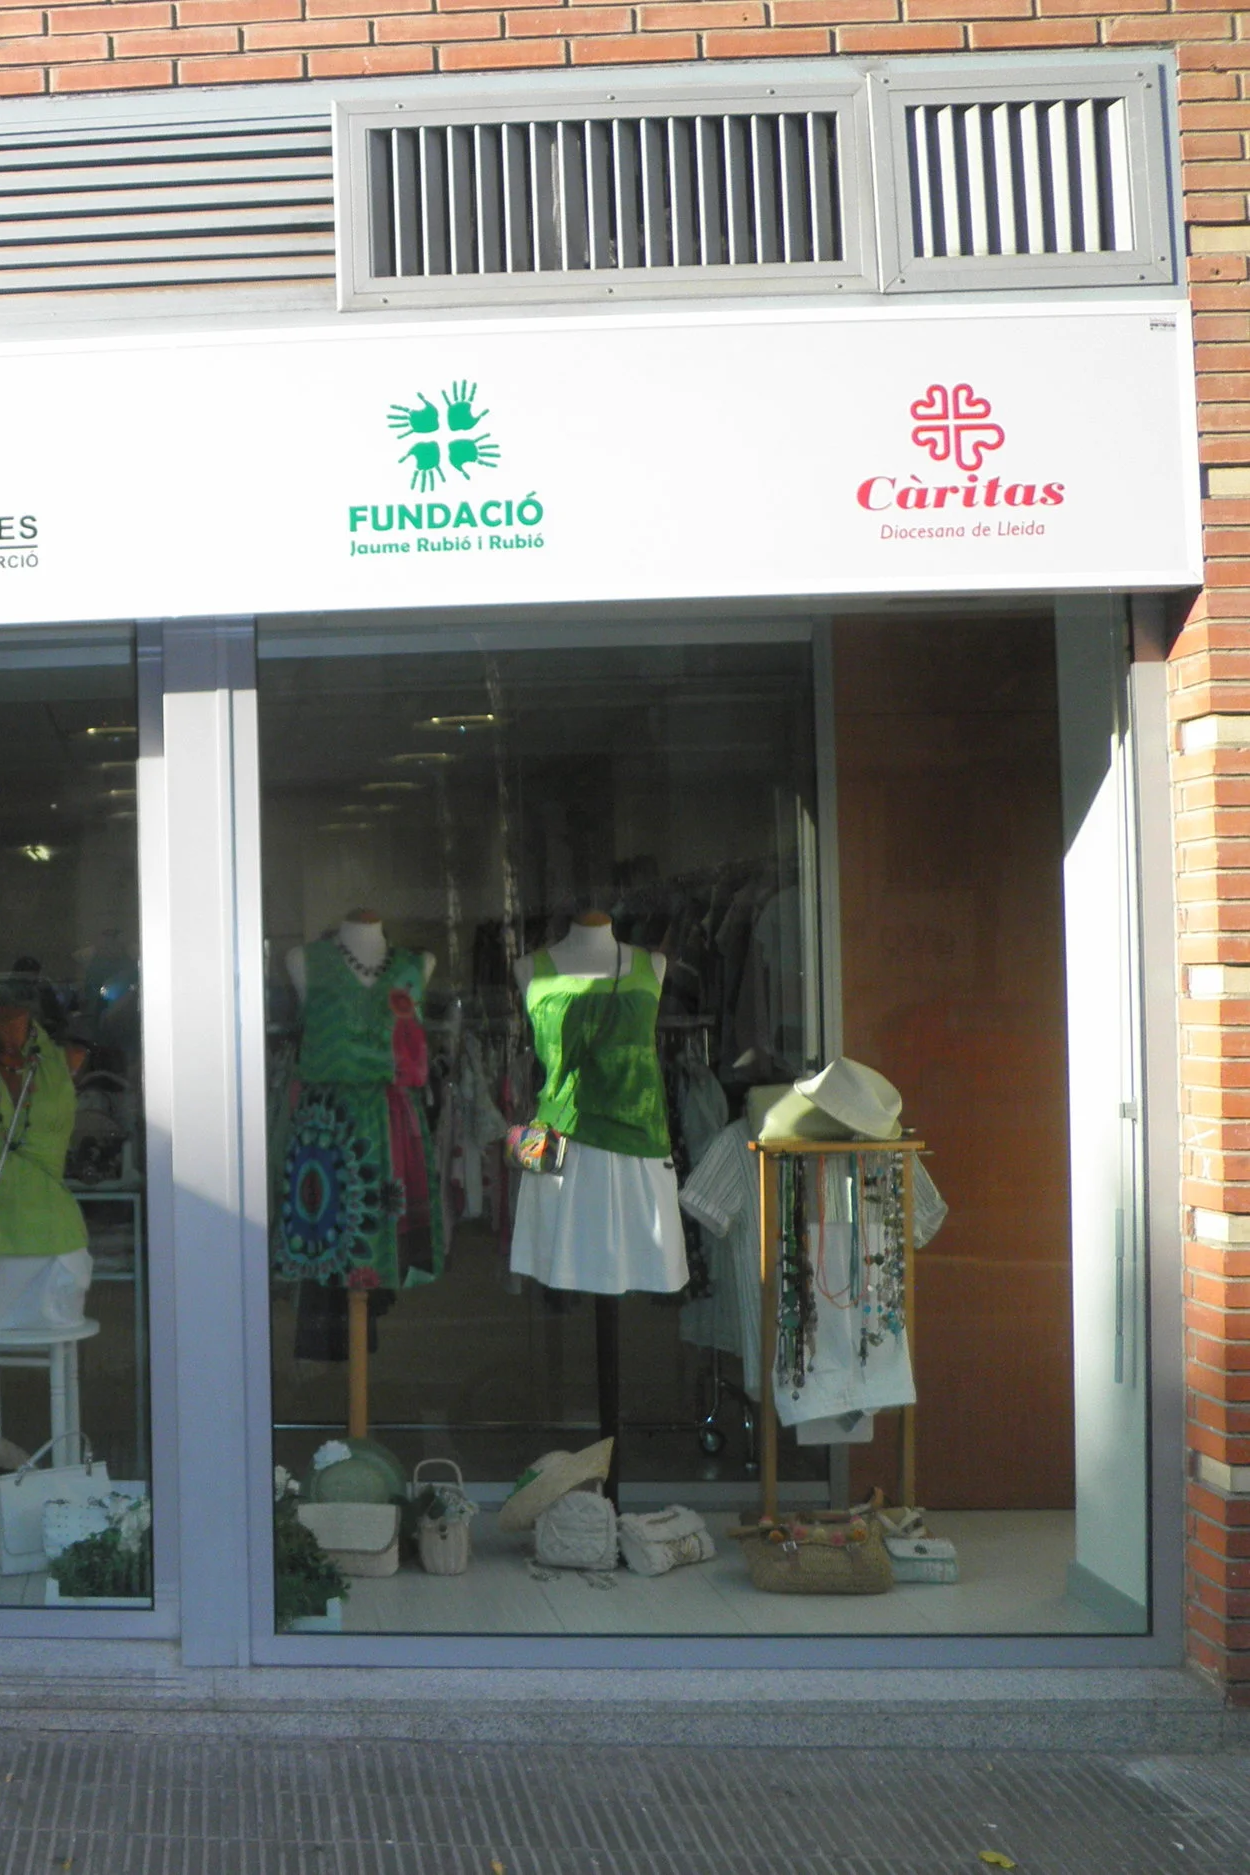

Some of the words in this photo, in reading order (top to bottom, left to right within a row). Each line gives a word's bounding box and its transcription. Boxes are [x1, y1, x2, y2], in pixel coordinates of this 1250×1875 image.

[856, 474, 1065, 511] Càritas
[349, 491, 544, 532] FUNDACIÓ
[350, 540, 410, 557] Jaume
[417, 536, 471, 552] Rubió
[477, 536, 483, 550] i
[489, 533, 545, 550] Rubió
[880, 523, 965, 540] Diocesana
[971, 522, 991, 537] de
[997, 520, 1046, 537] Lleida
